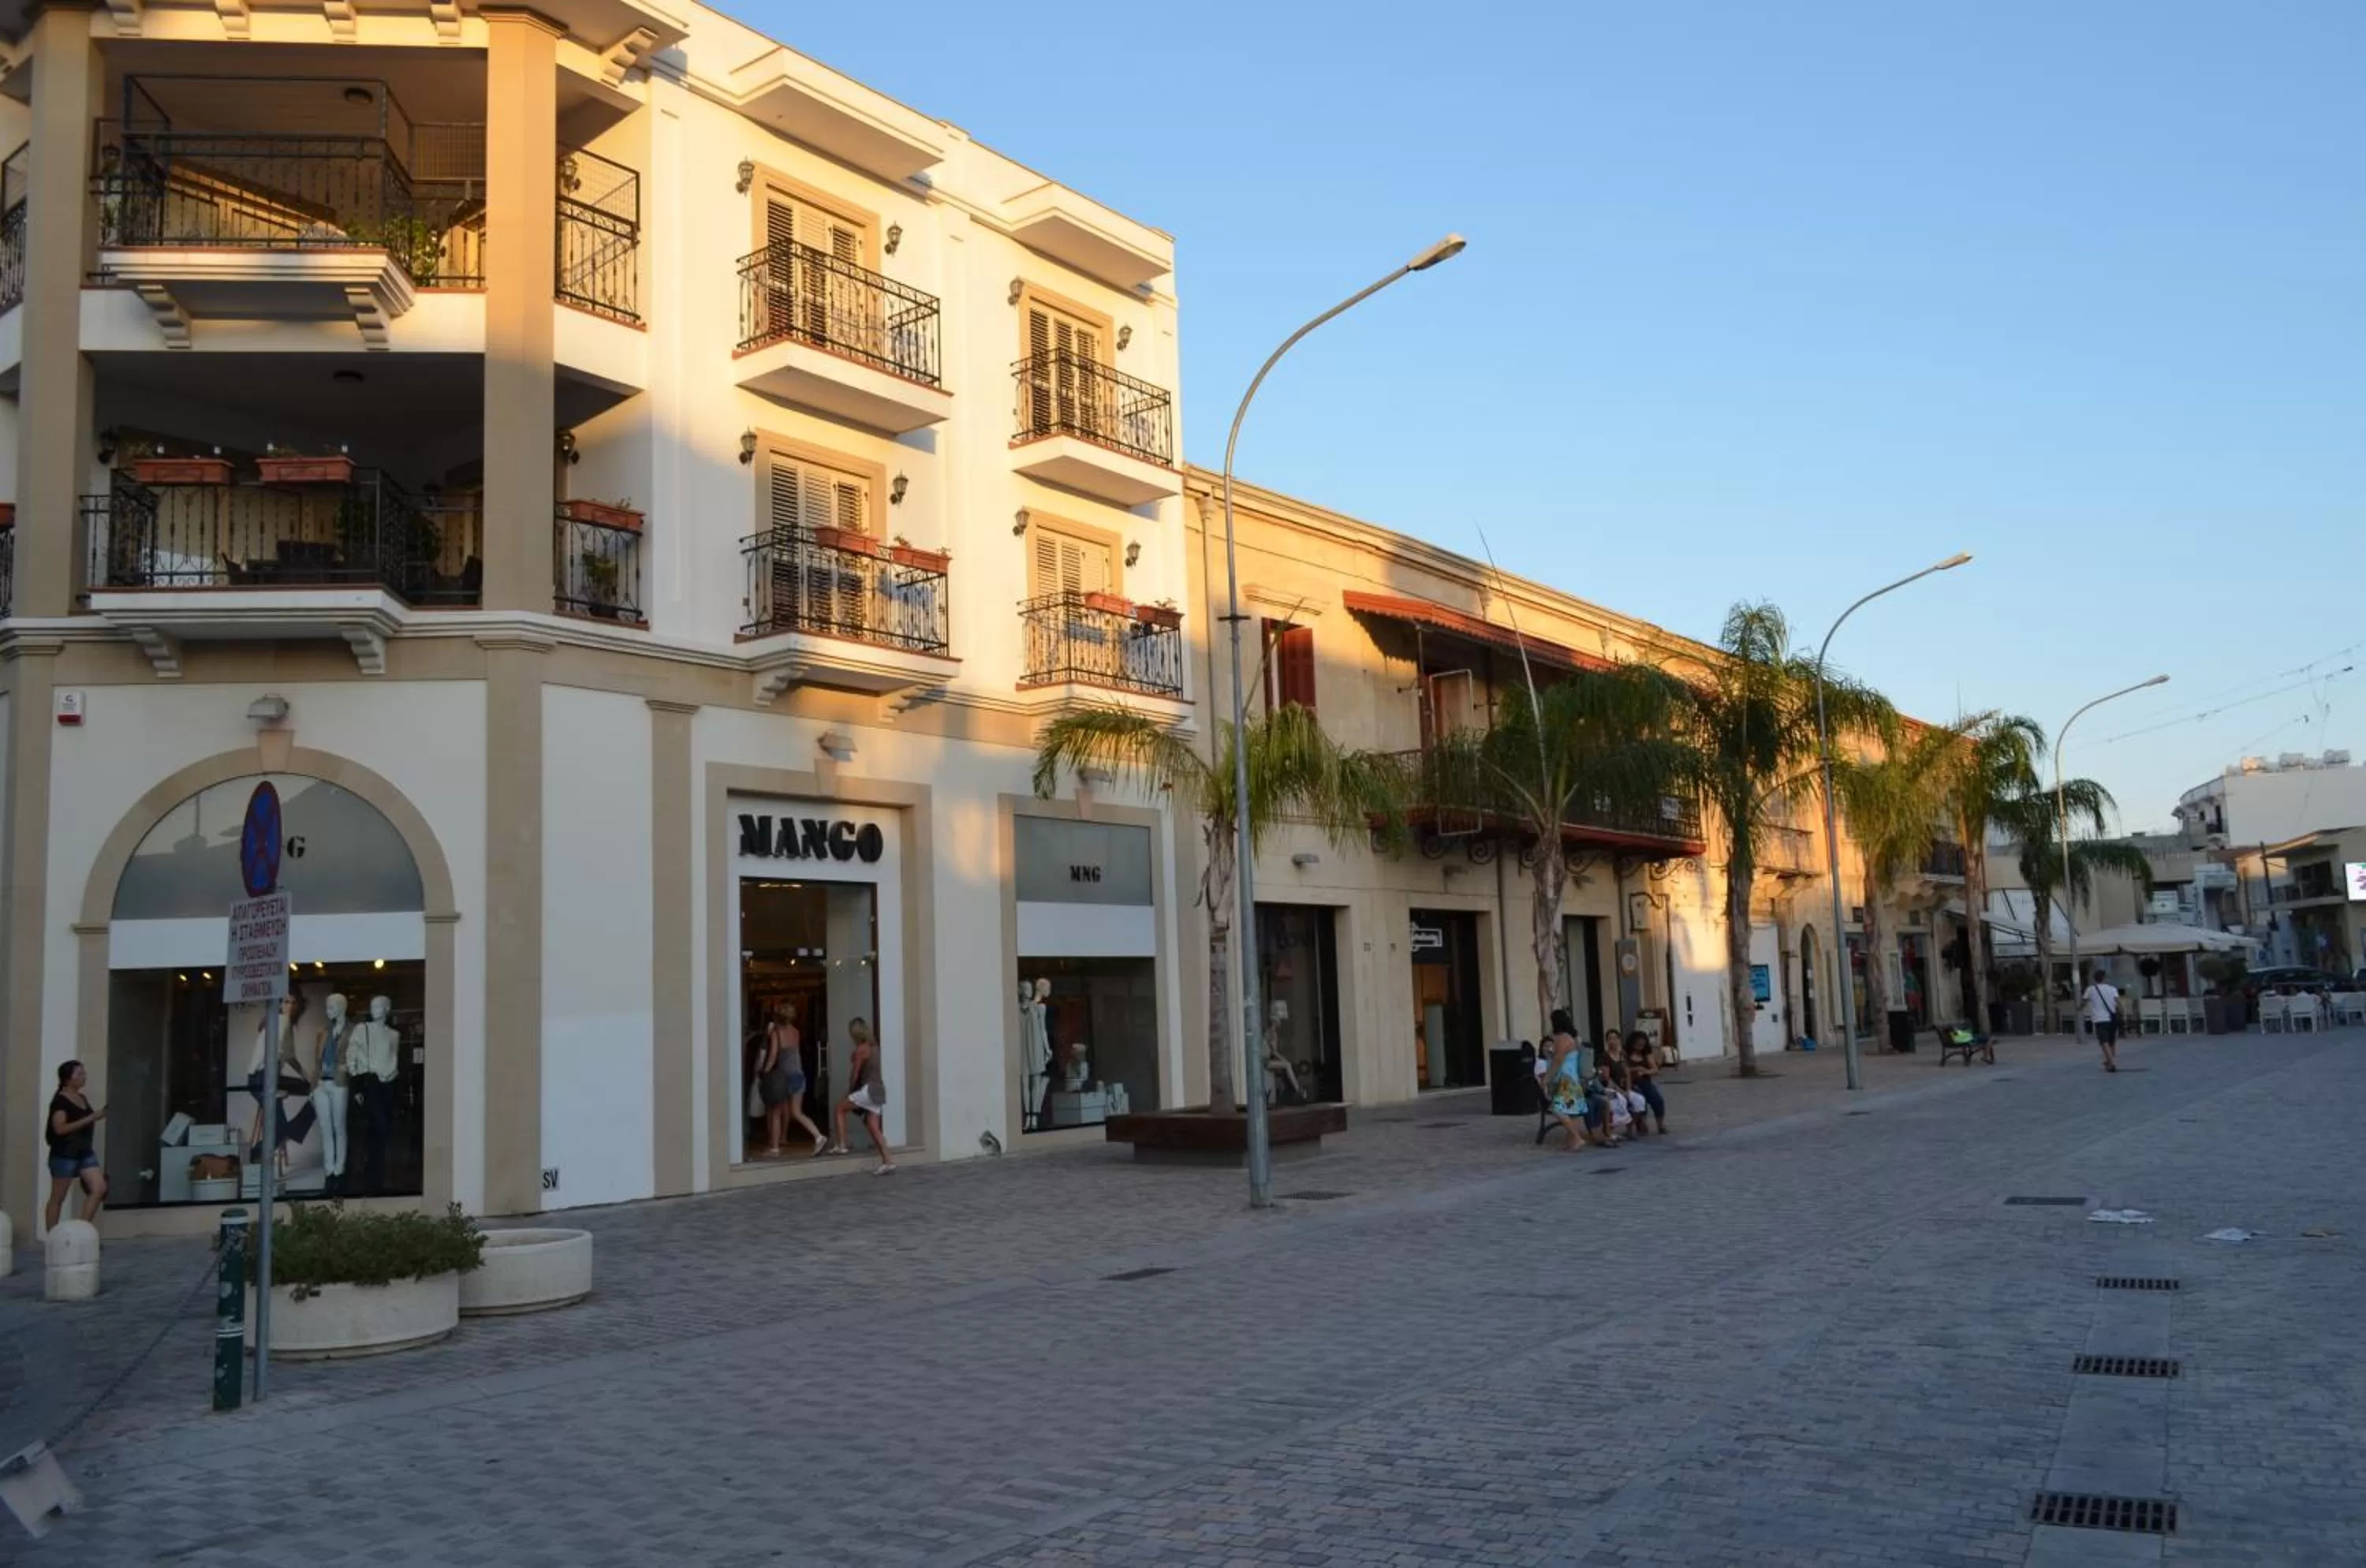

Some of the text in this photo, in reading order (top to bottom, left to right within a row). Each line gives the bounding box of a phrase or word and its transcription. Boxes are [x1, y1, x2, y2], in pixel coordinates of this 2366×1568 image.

[737, 814, 884, 863] MANGO
[1069, 864, 1101, 883] MNG
[543, 1170, 558, 1189] SV
